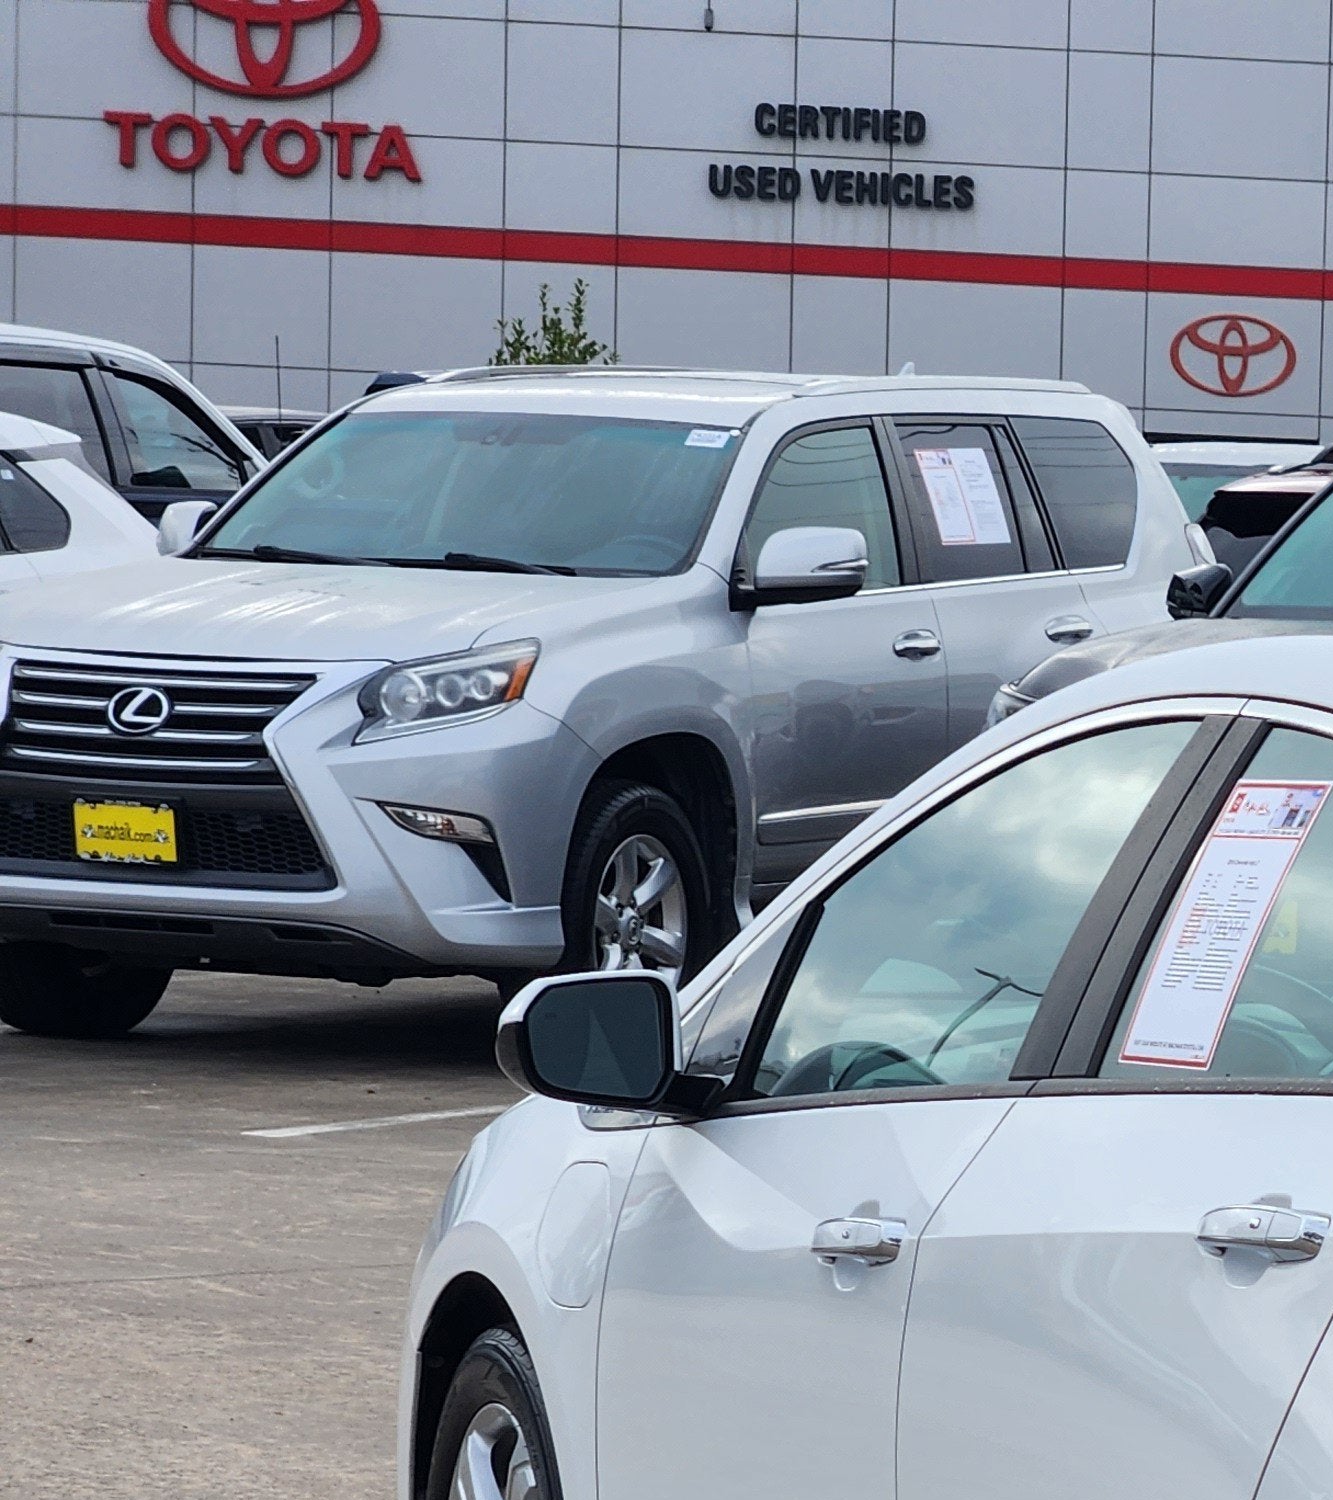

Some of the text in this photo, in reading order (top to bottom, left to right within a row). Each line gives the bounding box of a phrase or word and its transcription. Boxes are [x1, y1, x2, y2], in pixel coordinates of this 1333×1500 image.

[103, 109, 422, 183] TOYOTA
[754, 103, 927, 146] CERTIFIED
[708, 164, 975, 211] USED VEHICLES
